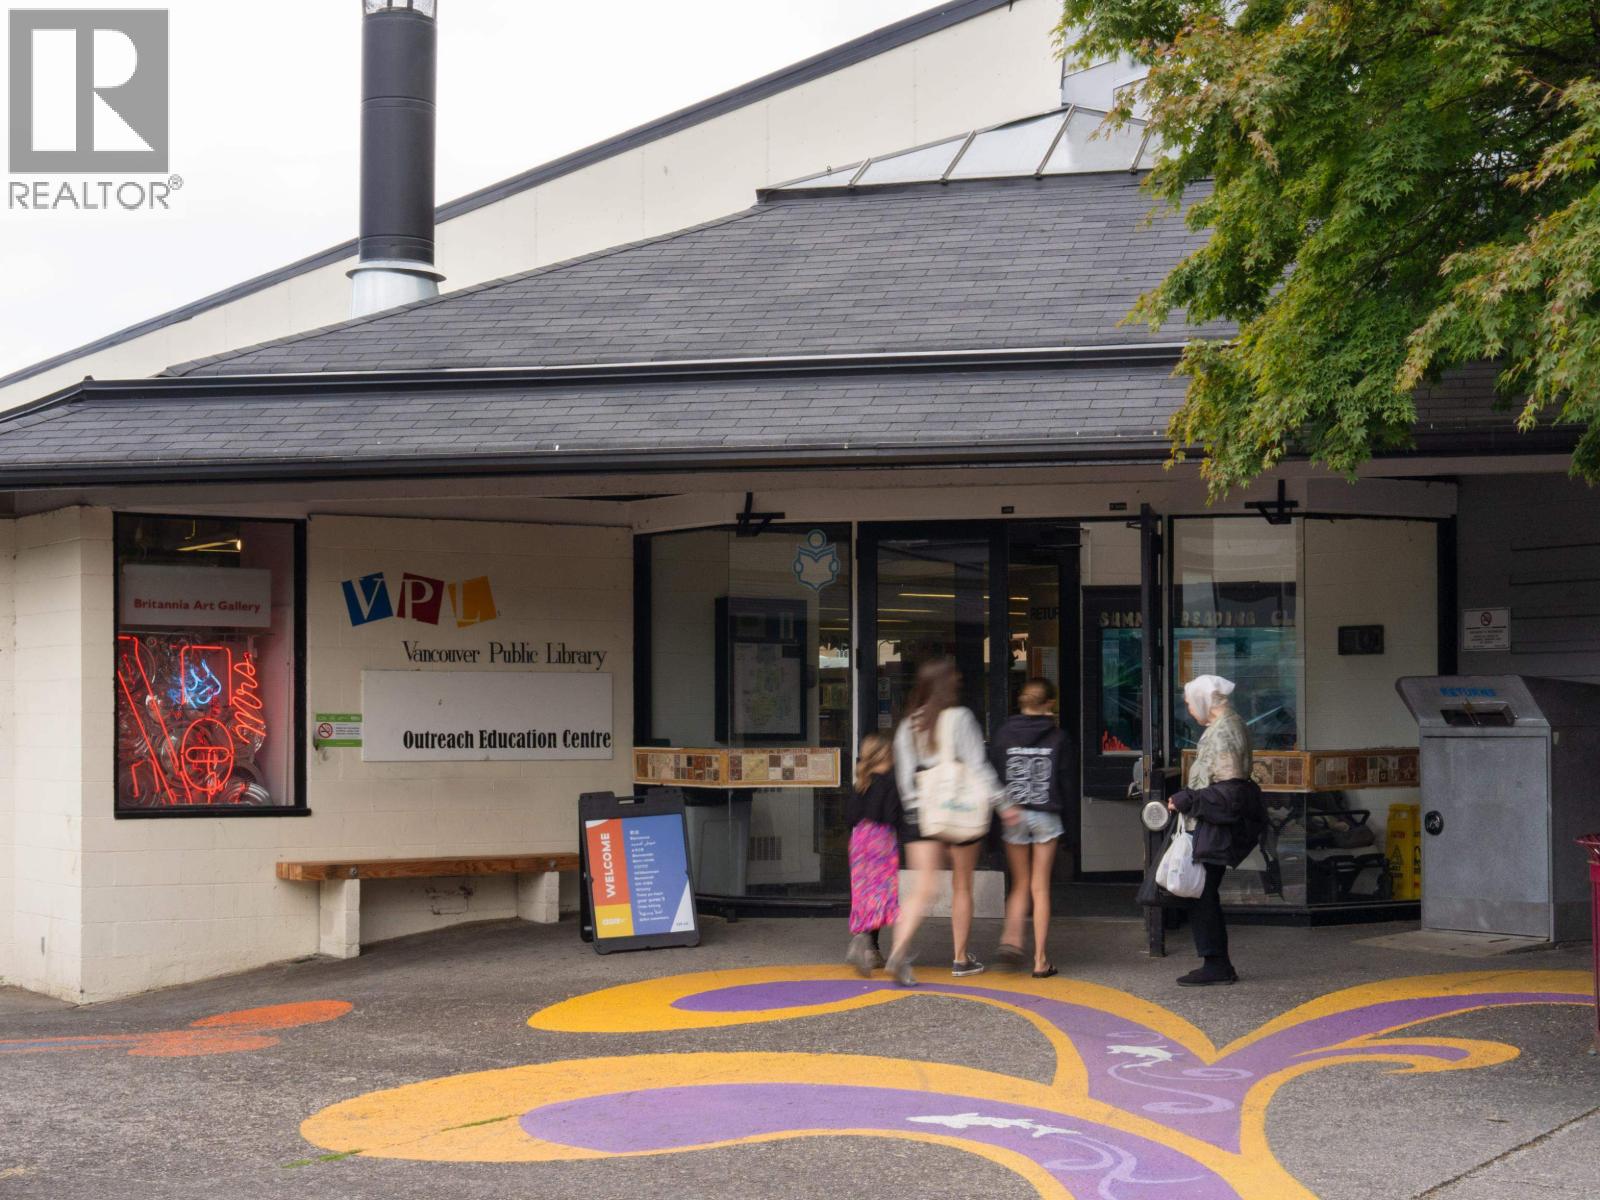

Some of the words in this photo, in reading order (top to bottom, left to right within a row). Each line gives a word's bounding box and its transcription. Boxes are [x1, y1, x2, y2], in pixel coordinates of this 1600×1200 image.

[133, 598, 190, 610] Britannia
[193, 600, 215, 610] Art
[218, 600, 261, 613] Gallery
[346, 573, 488, 625] VPL
[402, 640, 481, 664] Vancouver
[488, 641, 539, 665] Public
[546, 642, 608, 671] Library
[403, 729, 475, 750] Outreach
[479, 729, 558, 750] Education
[562, 729, 612, 750] Centre
[600, 832, 617, 899] WELCOME
